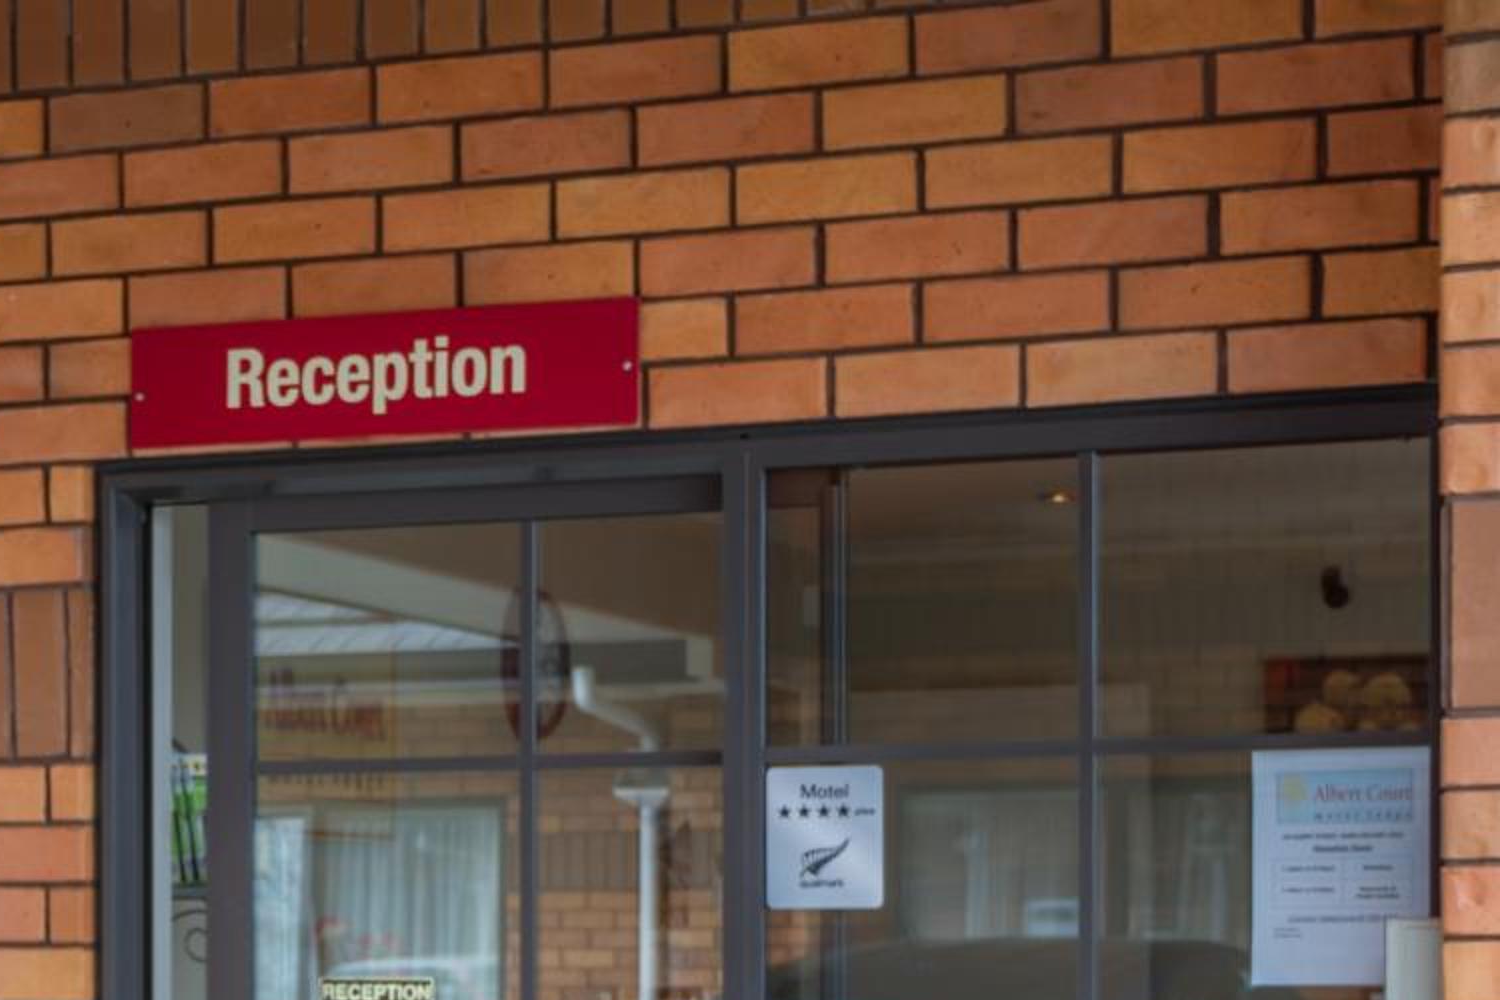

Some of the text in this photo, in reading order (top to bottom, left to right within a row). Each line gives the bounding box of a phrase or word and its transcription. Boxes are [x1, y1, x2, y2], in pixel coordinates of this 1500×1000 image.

[226, 335, 527, 415] Reception
[801, 784, 850, 799] Motel
[322, 983, 433, 1000] RECEPTION
